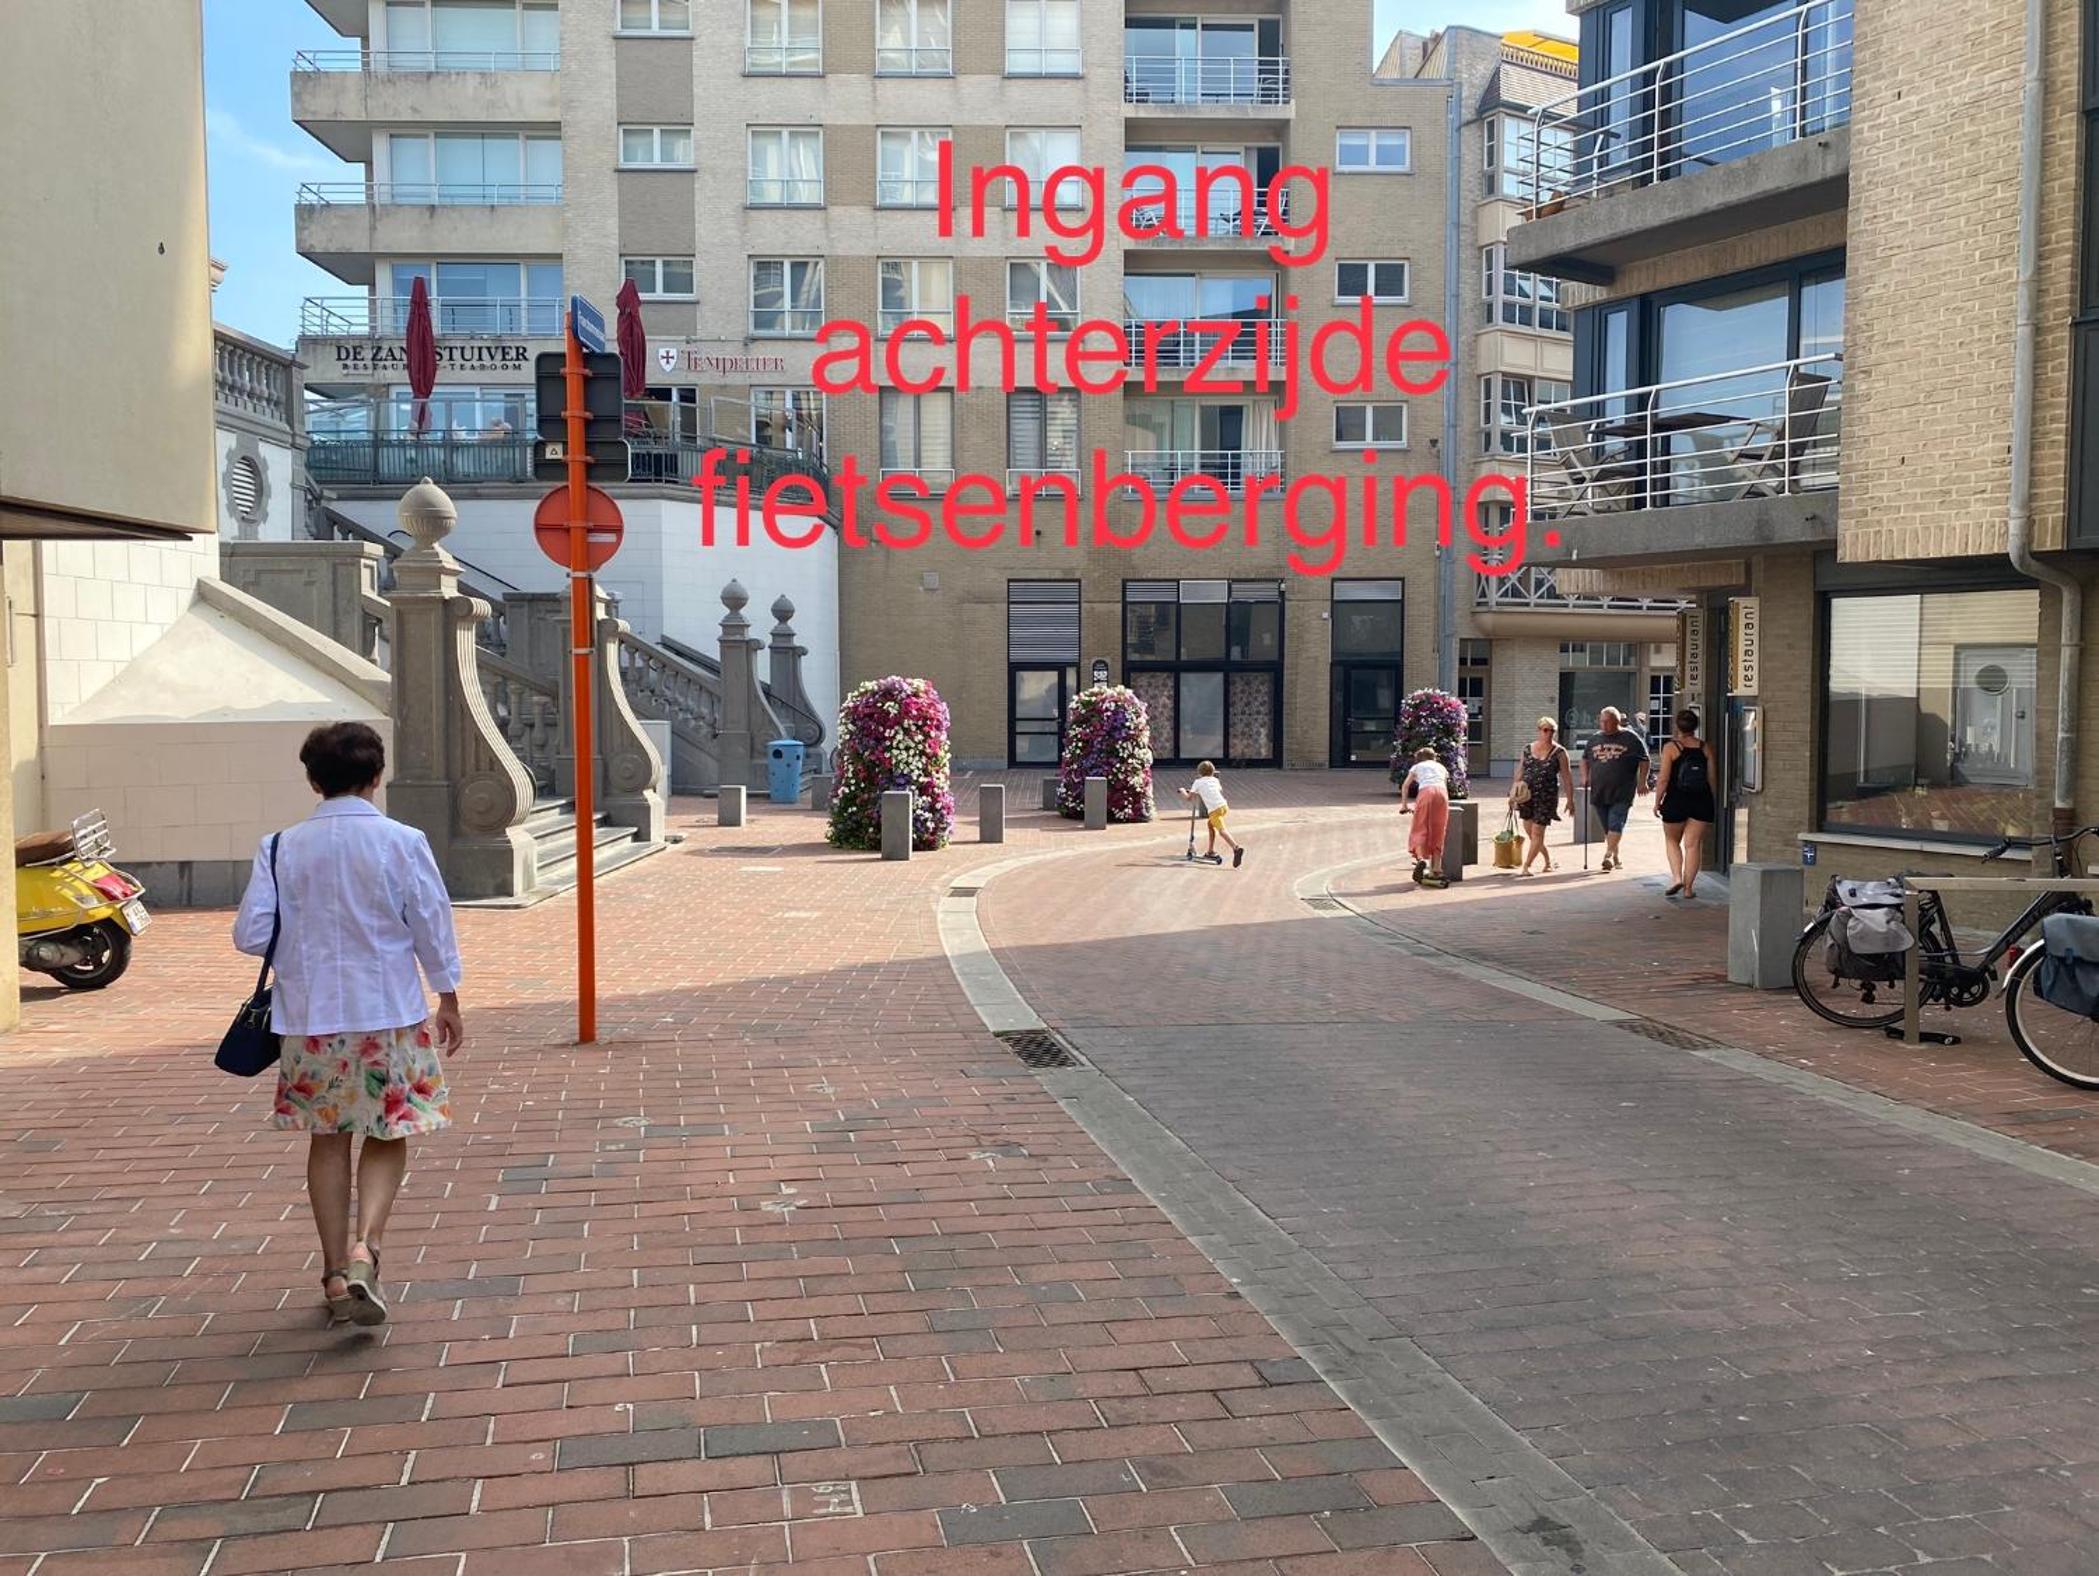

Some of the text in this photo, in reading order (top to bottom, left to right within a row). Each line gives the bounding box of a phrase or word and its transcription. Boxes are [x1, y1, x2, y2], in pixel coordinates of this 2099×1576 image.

[335, 345, 529, 361] DE ZANSTUIVER
[1689, 614, 1699, 686] restaurant
[1742, 605, 1754, 688] restaurant
